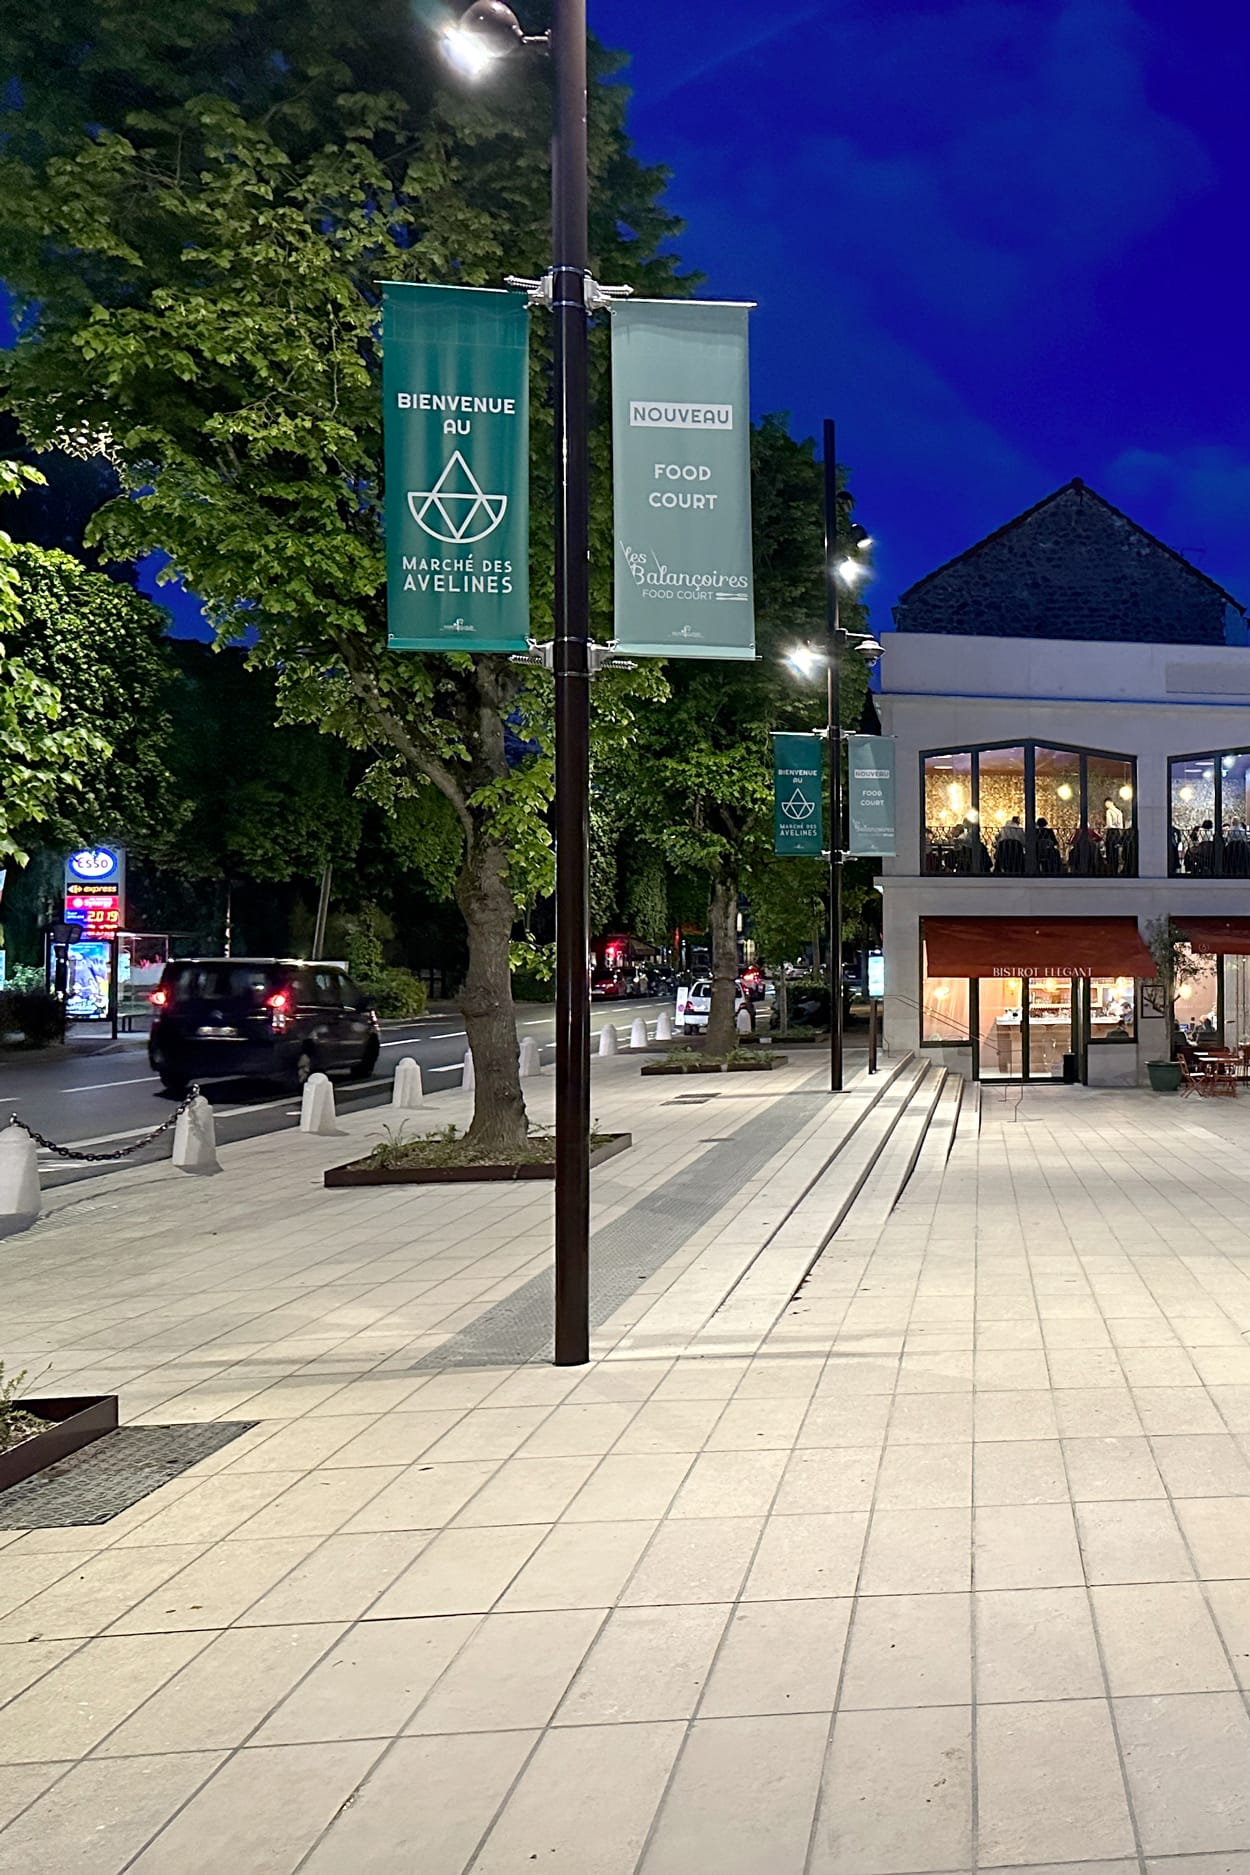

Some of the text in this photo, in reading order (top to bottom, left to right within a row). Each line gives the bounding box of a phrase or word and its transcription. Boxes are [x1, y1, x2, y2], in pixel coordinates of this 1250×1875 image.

[397, 392, 516, 415] BIENVENUE
[633, 408, 730, 424] NOUVEAU
[443, 418, 471, 435] AU
[654, 463, 711, 481] FOOD
[648, 492, 718, 510] COURT
[482, 559, 513, 573] DES
[402, 575, 513, 593] AVELINES
[631, 563, 749, 591] Balançoires
[642, 589, 714, 600] FOOD COURT
[992, 967, 1092, 977] BISTROT ELEGANT
